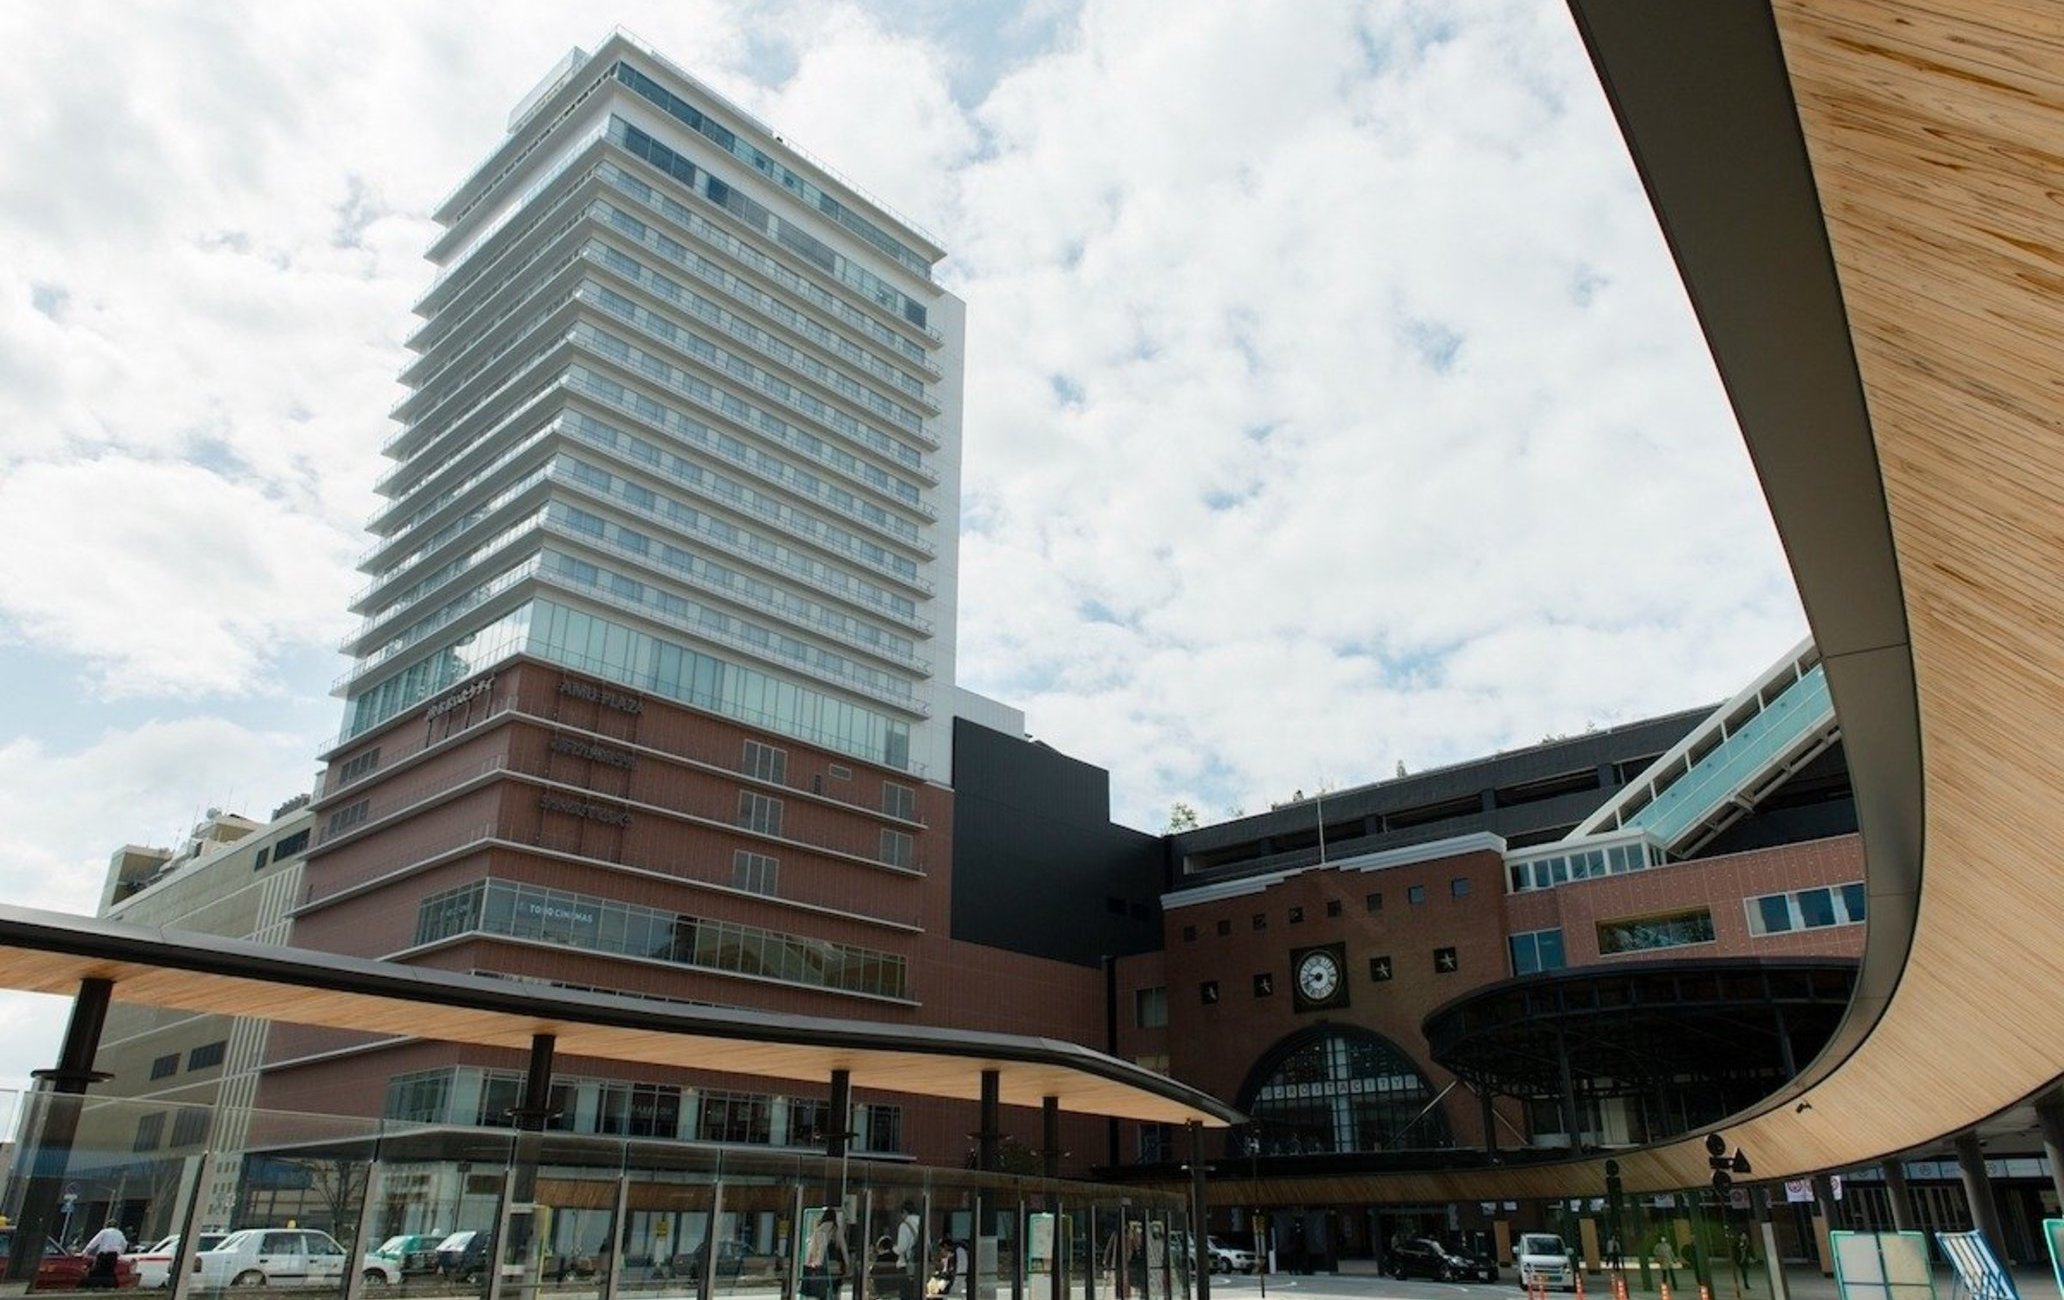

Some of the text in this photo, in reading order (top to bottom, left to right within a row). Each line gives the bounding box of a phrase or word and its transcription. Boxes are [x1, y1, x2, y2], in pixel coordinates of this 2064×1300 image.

[560, 680, 645, 715] AMU PLAZA
[555, 909, 593, 924] CINMAS
